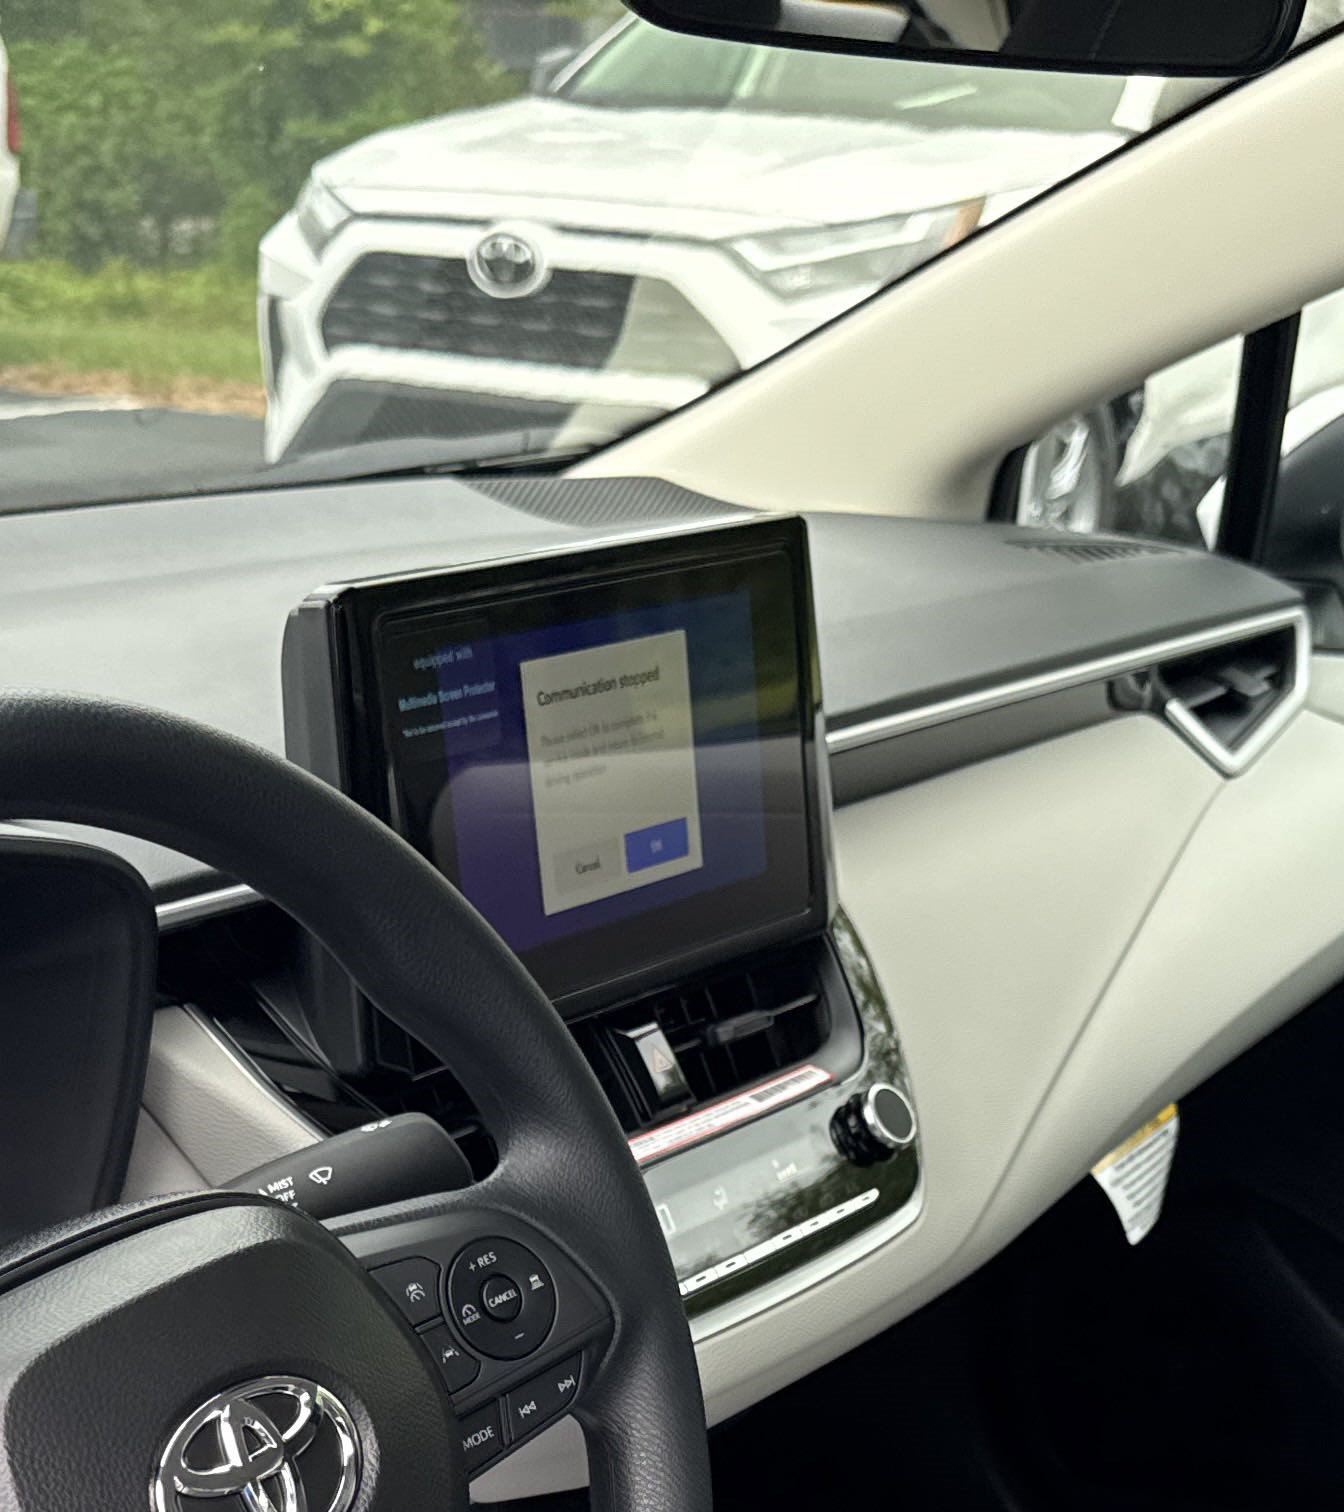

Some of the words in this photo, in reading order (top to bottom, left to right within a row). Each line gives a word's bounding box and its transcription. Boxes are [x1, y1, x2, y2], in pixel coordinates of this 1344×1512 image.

[536, 677, 618, 706] Communication
[619, 664, 660, 689] stopped
[267, 1176, 294, 1194] MIST
[477, 1251, 497, 1269] RES
[488, 1289, 518, 1308] CANCEL
[463, 1425, 495, 1452] MODE
